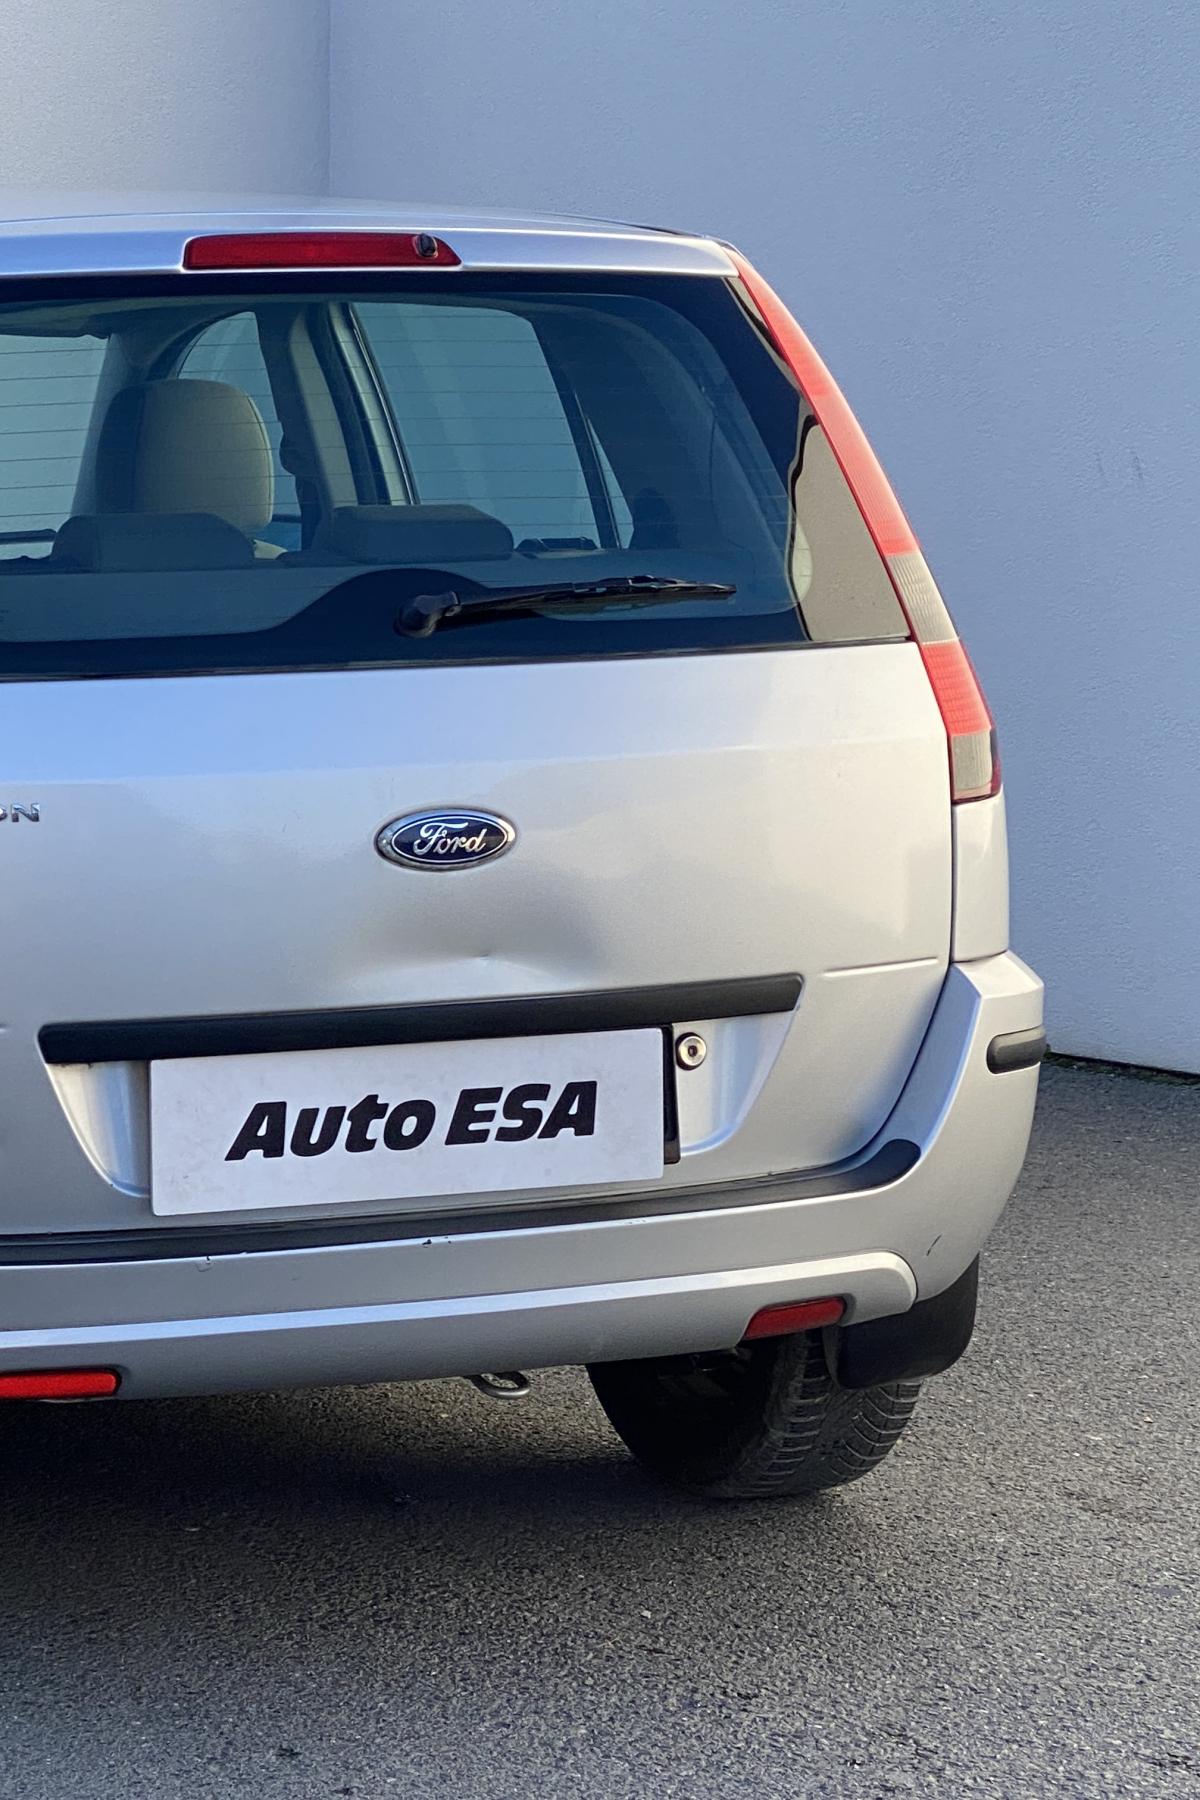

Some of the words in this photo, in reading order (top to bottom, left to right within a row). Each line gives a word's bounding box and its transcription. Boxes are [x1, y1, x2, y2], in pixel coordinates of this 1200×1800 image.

[412, 821, 487, 856] Ford
[224, 1093, 437, 1162] Auto
[444, 1080, 599, 1146] ESA
